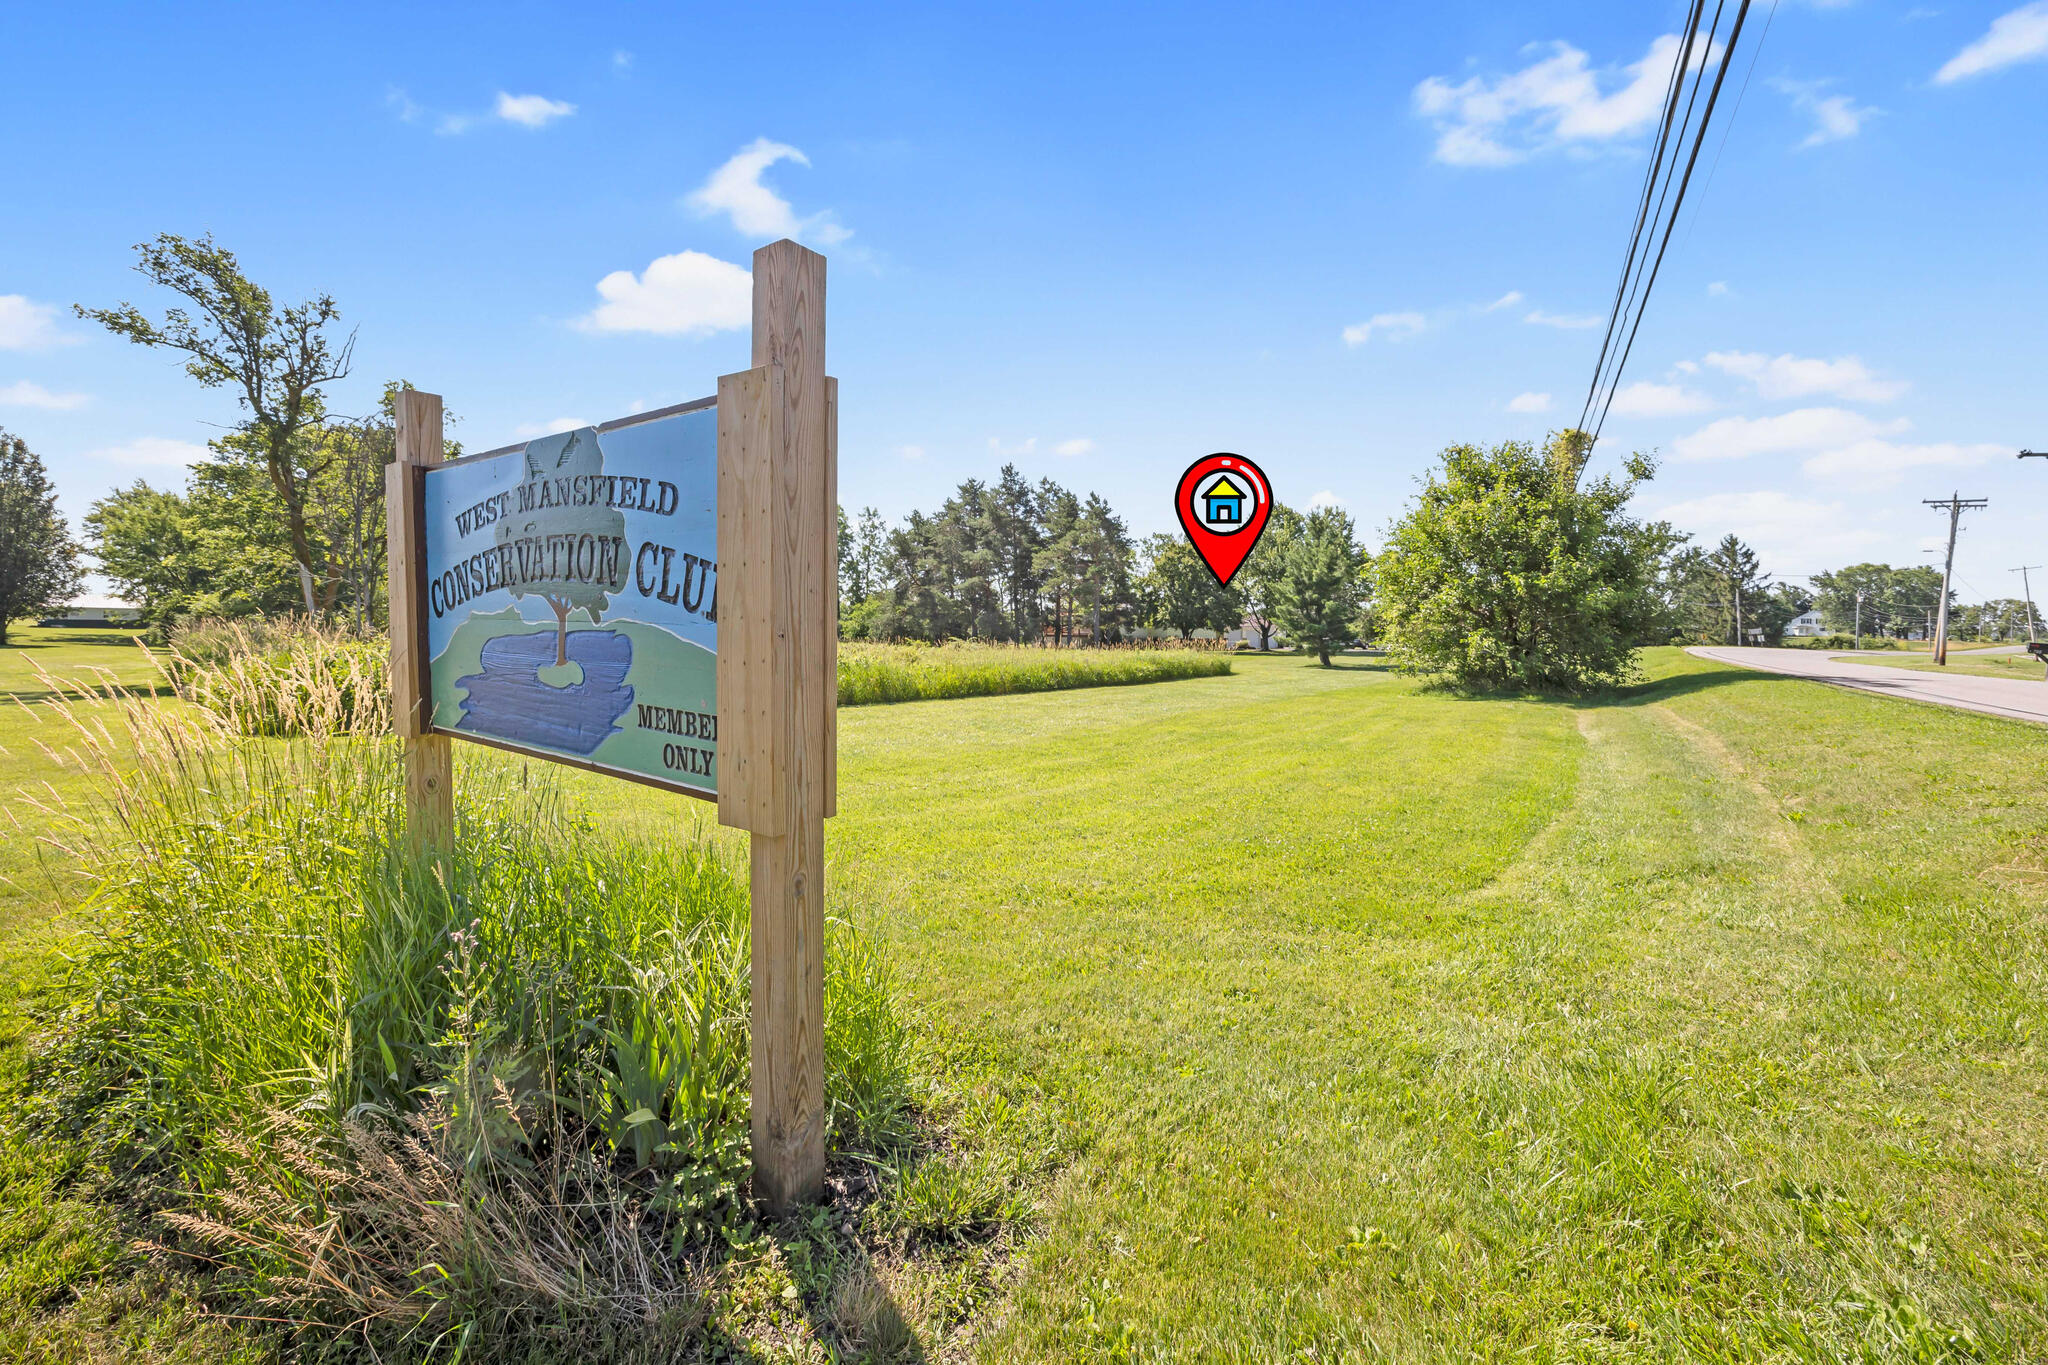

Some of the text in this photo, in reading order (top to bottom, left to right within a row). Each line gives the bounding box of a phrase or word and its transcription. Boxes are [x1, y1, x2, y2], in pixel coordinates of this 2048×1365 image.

[455, 474, 680, 539] WEST MANSFIELD
[431, 532, 718, 624] CONSERVATION CLU
[636, 703, 718, 742] MEMBE
[662, 742, 716, 777] ONLY
